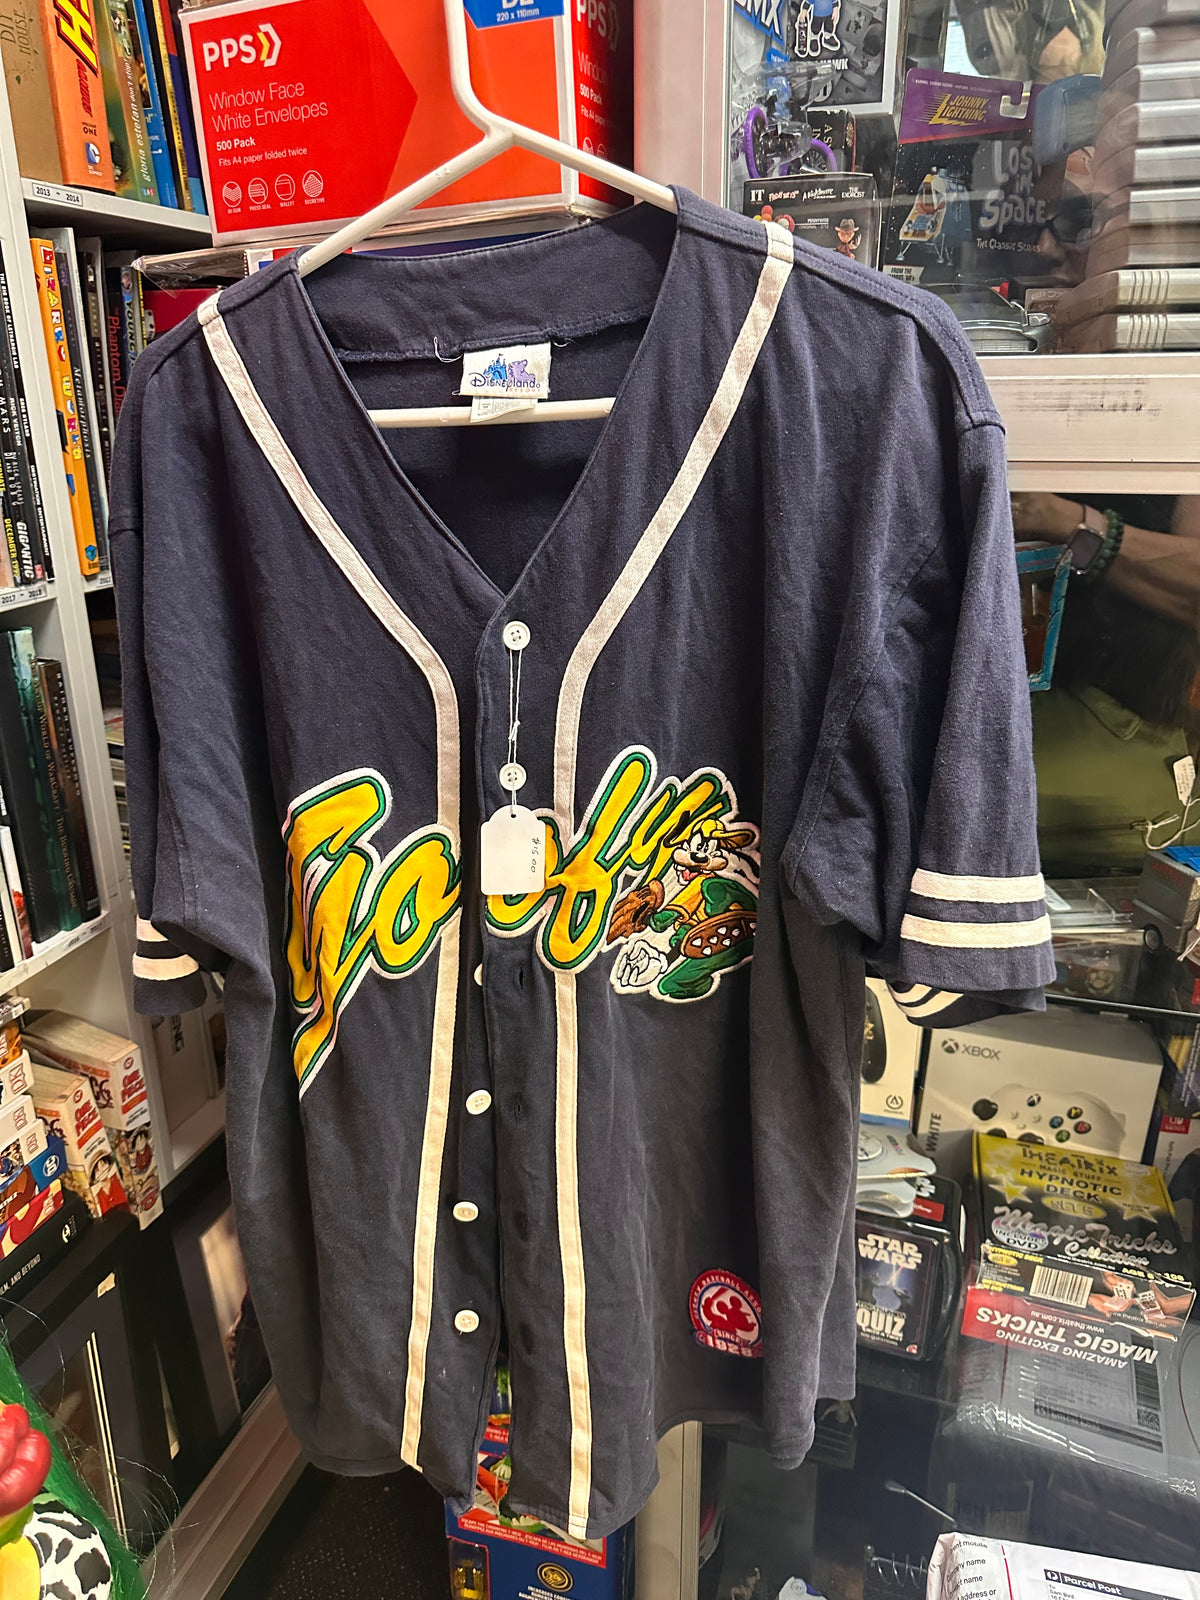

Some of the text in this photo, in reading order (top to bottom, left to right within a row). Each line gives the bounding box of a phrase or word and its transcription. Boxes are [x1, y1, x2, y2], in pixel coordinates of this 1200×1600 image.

[496, 11, 509, 22] 220
[516, 8, 540, 18] 110mm
[14, 9, 31, 55] HOUSE
[202, 34, 257, 71] PPS
[209, 82, 305, 111] Window Face
[580, 83, 602, 105] 500 Pack
[949, 94, 990, 109] JOHNNY
[123, 58, 151, 182] gloria estefan don't stop!
[212, 102, 328, 133] White Envelopes
[928, 93, 987, 126] LIGHTNING
[83, 127, 97, 136] ONE
[216, 136, 256, 151] 500 Pack
[219, 146, 308, 167] Fits A4 paper folded twice
[36, 186, 80, 203] 2013 2014
[750, 189, 765, 202] IT
[124, 301, 136, 353] YOUNG
[108, 315, 122, 382] Phantom
[468, 371, 537, 393] Disneyland
[9, 397, 22, 447] RICK VEITCH
[73, 366, 91, 458] Metamorphosis
[4, 518, 17, 559] DECEMBER
[16, 521, 35, 579] GIGANTIC
[961, 1043, 1001, 1061] XBOX
[9, 1062, 27, 1095] DK
[13, 1105, 28, 1131] DK
[26, 1131, 39, 1155] DK
[925, 1111, 942, 1152] WHITE
[1020, 1168, 1123, 1196] HYPNOTIC
[1045, 1183, 1100, 1202] DECK
[858, 1233, 922, 1259] STAR
[1006, 1238, 1038, 1250] DVD
[1085, 1223, 1178, 1255] Tricks
[858, 1243, 922, 1270] WARS
[1065, 1241, 1150, 1266] Collection
[10, 1253, 41, 1291] AND BEYOND
[856, 1308, 906, 1337] QUIZ
[975, 1306, 1159, 1364] MAGIC TRICKS
[1030, 1310, 1105, 1334] www.theatrix.com.au
[995, 1330, 1128, 1369] AMAZING EXCITING
[966, 1558, 986, 1567] name
[963, 1575, 983, 1584] name
[988, 1588, 997, 1596] or
[1063, 1575, 1122, 1596] Parcel Post
